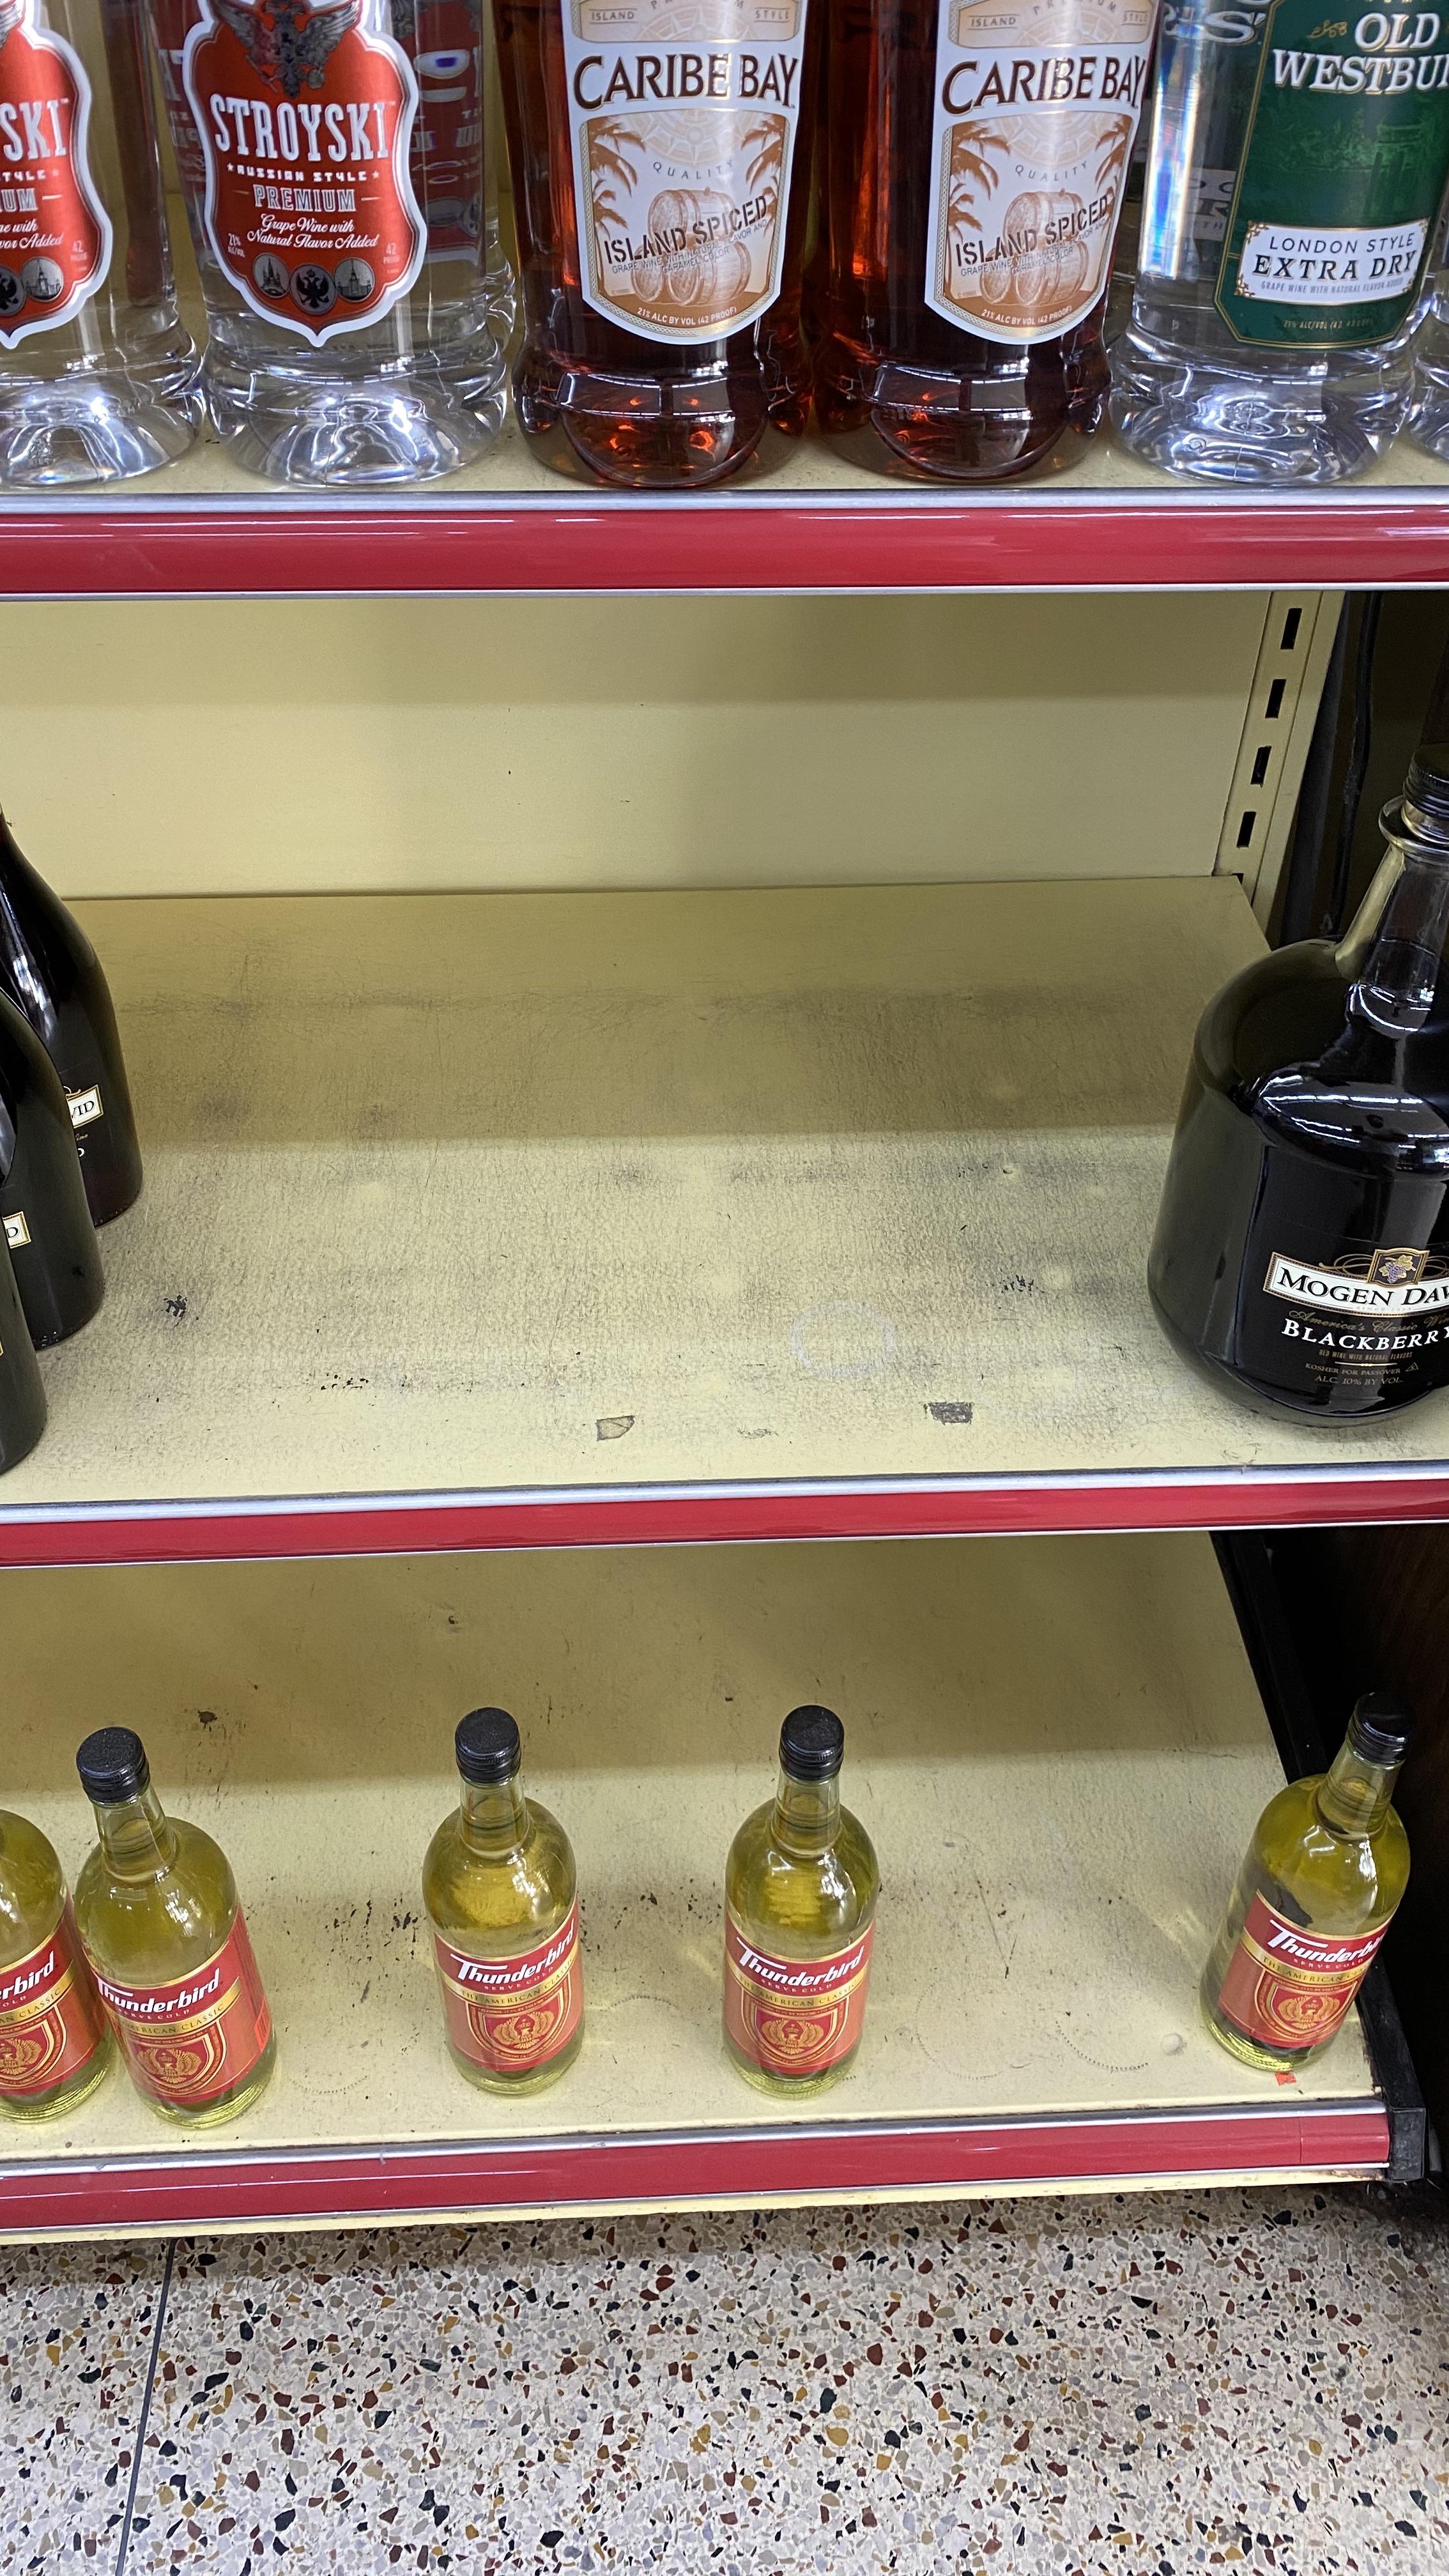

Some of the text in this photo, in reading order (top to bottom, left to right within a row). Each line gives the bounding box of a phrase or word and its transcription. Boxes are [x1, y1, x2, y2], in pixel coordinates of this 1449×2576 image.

[591, 8, 789, 20] ISLAND STYLE
[970, 17, 1016, 27] ISLAND
[1354, 13, 1441, 51] OLD
[573, 52, 798, 111] CARIBE BAY
[1272, 49, 1449, 95] WESTBU
[942, 55, 1146, 115] CARIBE BAY
[210, 93, 389, 162] STROYSKI
[237, 164, 367, 182] RUSSIAN STYLE
[653, 160, 733, 180] QUALITY
[1015, 161, 1088, 181] QUALITY
[252, 184, 356, 212] PREMIUM
[12, 218, 38, 233] with
[261, 213, 354, 234] Grape Wine with
[604, 195, 767, 264] ISLAND SPICED
[955, 195, 1108, 266] ISLAND SPICED
[19, 233, 65, 249] Added
[247, 227, 379, 249] Natural Flavor Added
[386, 242, 397, 255] 42
[611, 261, 639, 273] GRAPE
[641, 258, 663, 270] WINE
[687, 240, 723, 259] NATURAL
[753, 218, 767, 231] AND
[1269, 233, 1415, 254] LONDON STYLE
[703, 246, 730, 263] COLOR
[1252, 250, 1417, 280] EXTRA DRY
[961, 264, 988, 276] GRAPE
[991, 261, 1012, 272] WINE
[1261, 280, 1284, 292] GRAPE
[1288, 285, 1307, 293] WINE
[1310, 286, 1328, 294] WITH
[1330, 285, 1361, 294] NATURAL
[637, 307, 737, 325] 21% ALC BY VOL (42 PROOF)
[981, 309, 994, 319] 21%
[995, 313, 1009, 323] ALC
[1011, 316, 1022, 325] BY
[1022, 316, 1036, 325] VOL
[1049, 307, 1072, 322] PROOF)
[1277, 1267, 1394, 1306] MOGEN
[1288, 1310, 1366, 1331] America's
[1372, 1319, 1418, 1333] Classic
[1305, 1363, 1339, 1373] KOSHER
[1314, 1375, 1339, 1384] ALC
[450, 1917, 574, 1984] Thunderbird
[736, 1936, 865, 1986] Thunderbird
[1293, 1958, 1331, 1969] SERVE
[484, 1966, 554, 1991] SERVE COLD
[761, 1979, 832, 1993] SERVE COLD
[1285, 1970, 1342, 1982] AMERICAN
[96, 1968, 220, 2012] Thunderbird
[484, 1988, 540, 2004] AMERICAN
[19, 1987, 61, 2018] CLASSIC
[157, 2009, 190, 2020] COLD
[181, 2004, 224, 2030] CLASSIC
